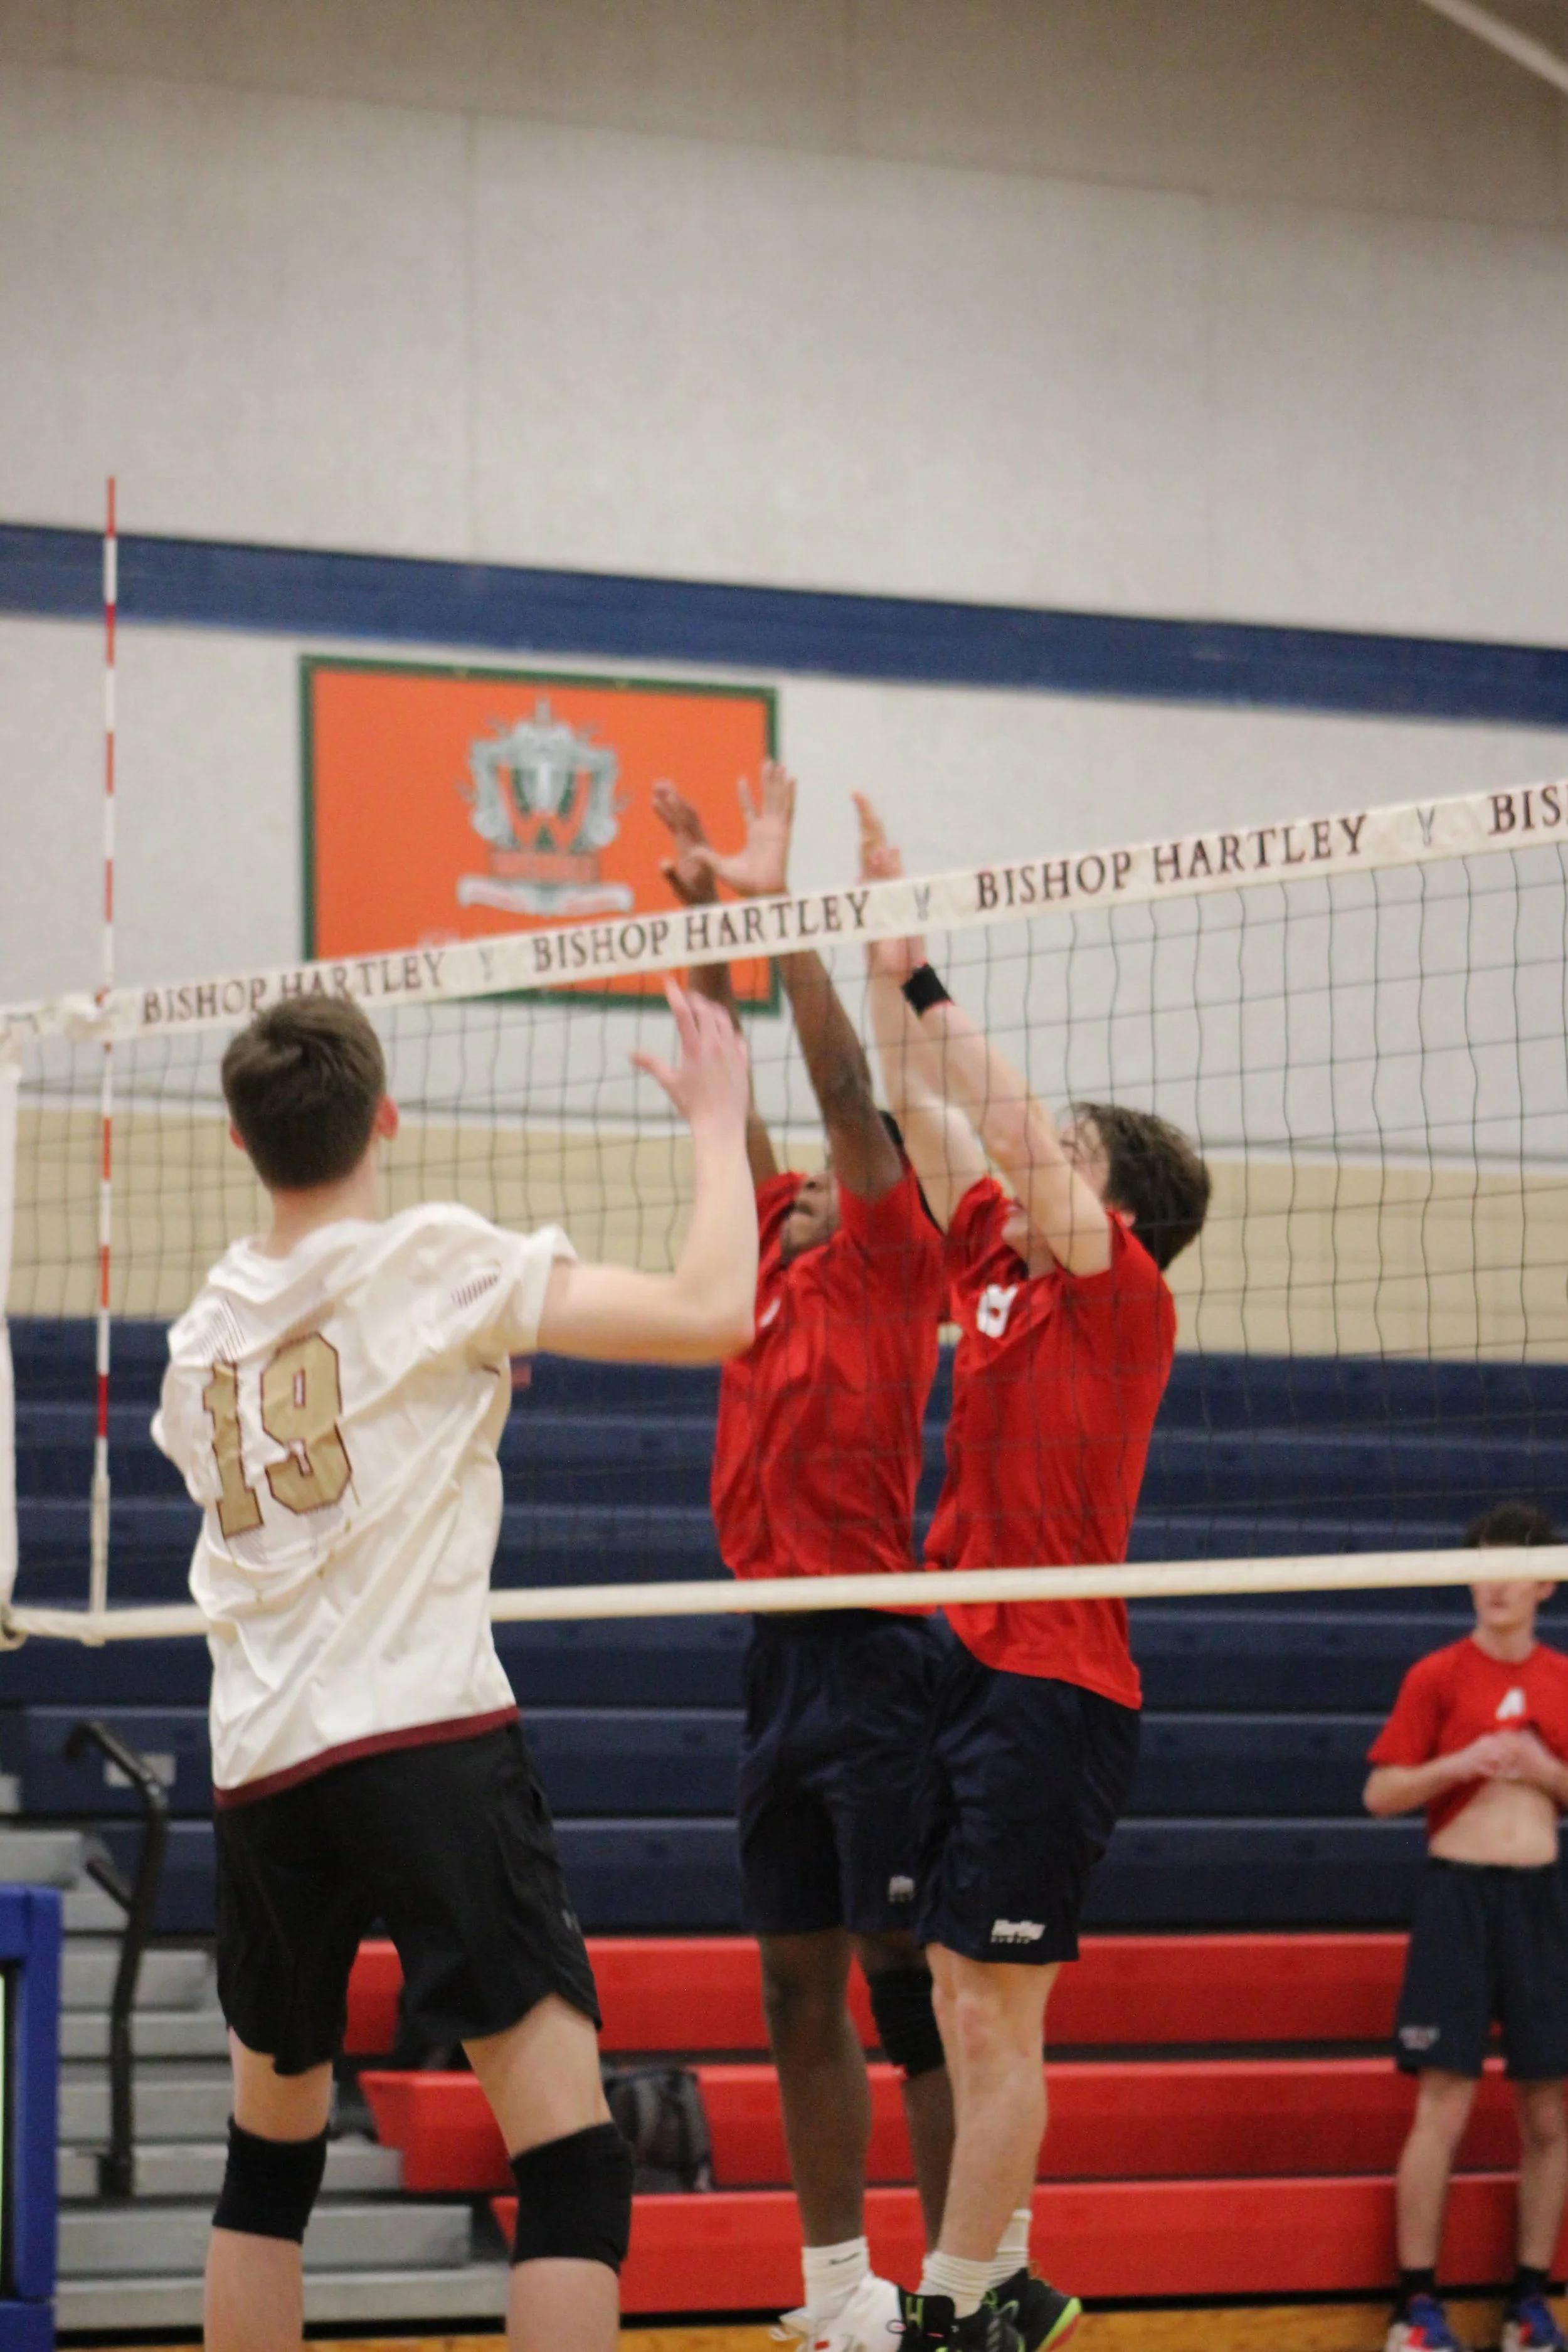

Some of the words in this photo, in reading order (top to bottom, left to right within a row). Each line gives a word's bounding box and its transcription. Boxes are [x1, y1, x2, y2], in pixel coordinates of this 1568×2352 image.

[1487, 784, 1568, 836] BIS
[976, 851, 1131, 911] BISHOP
[1152, 813, 1368, 884] HARTLEY
[532, 918, 669, 972] BISHOP
[685, 891, 871, 951] HARTLEY
[142, 977, 267, 1025] BISHOP
[280, 951, 446, 999] HARTLEY
[202, 1330, 353, 1540] 19
